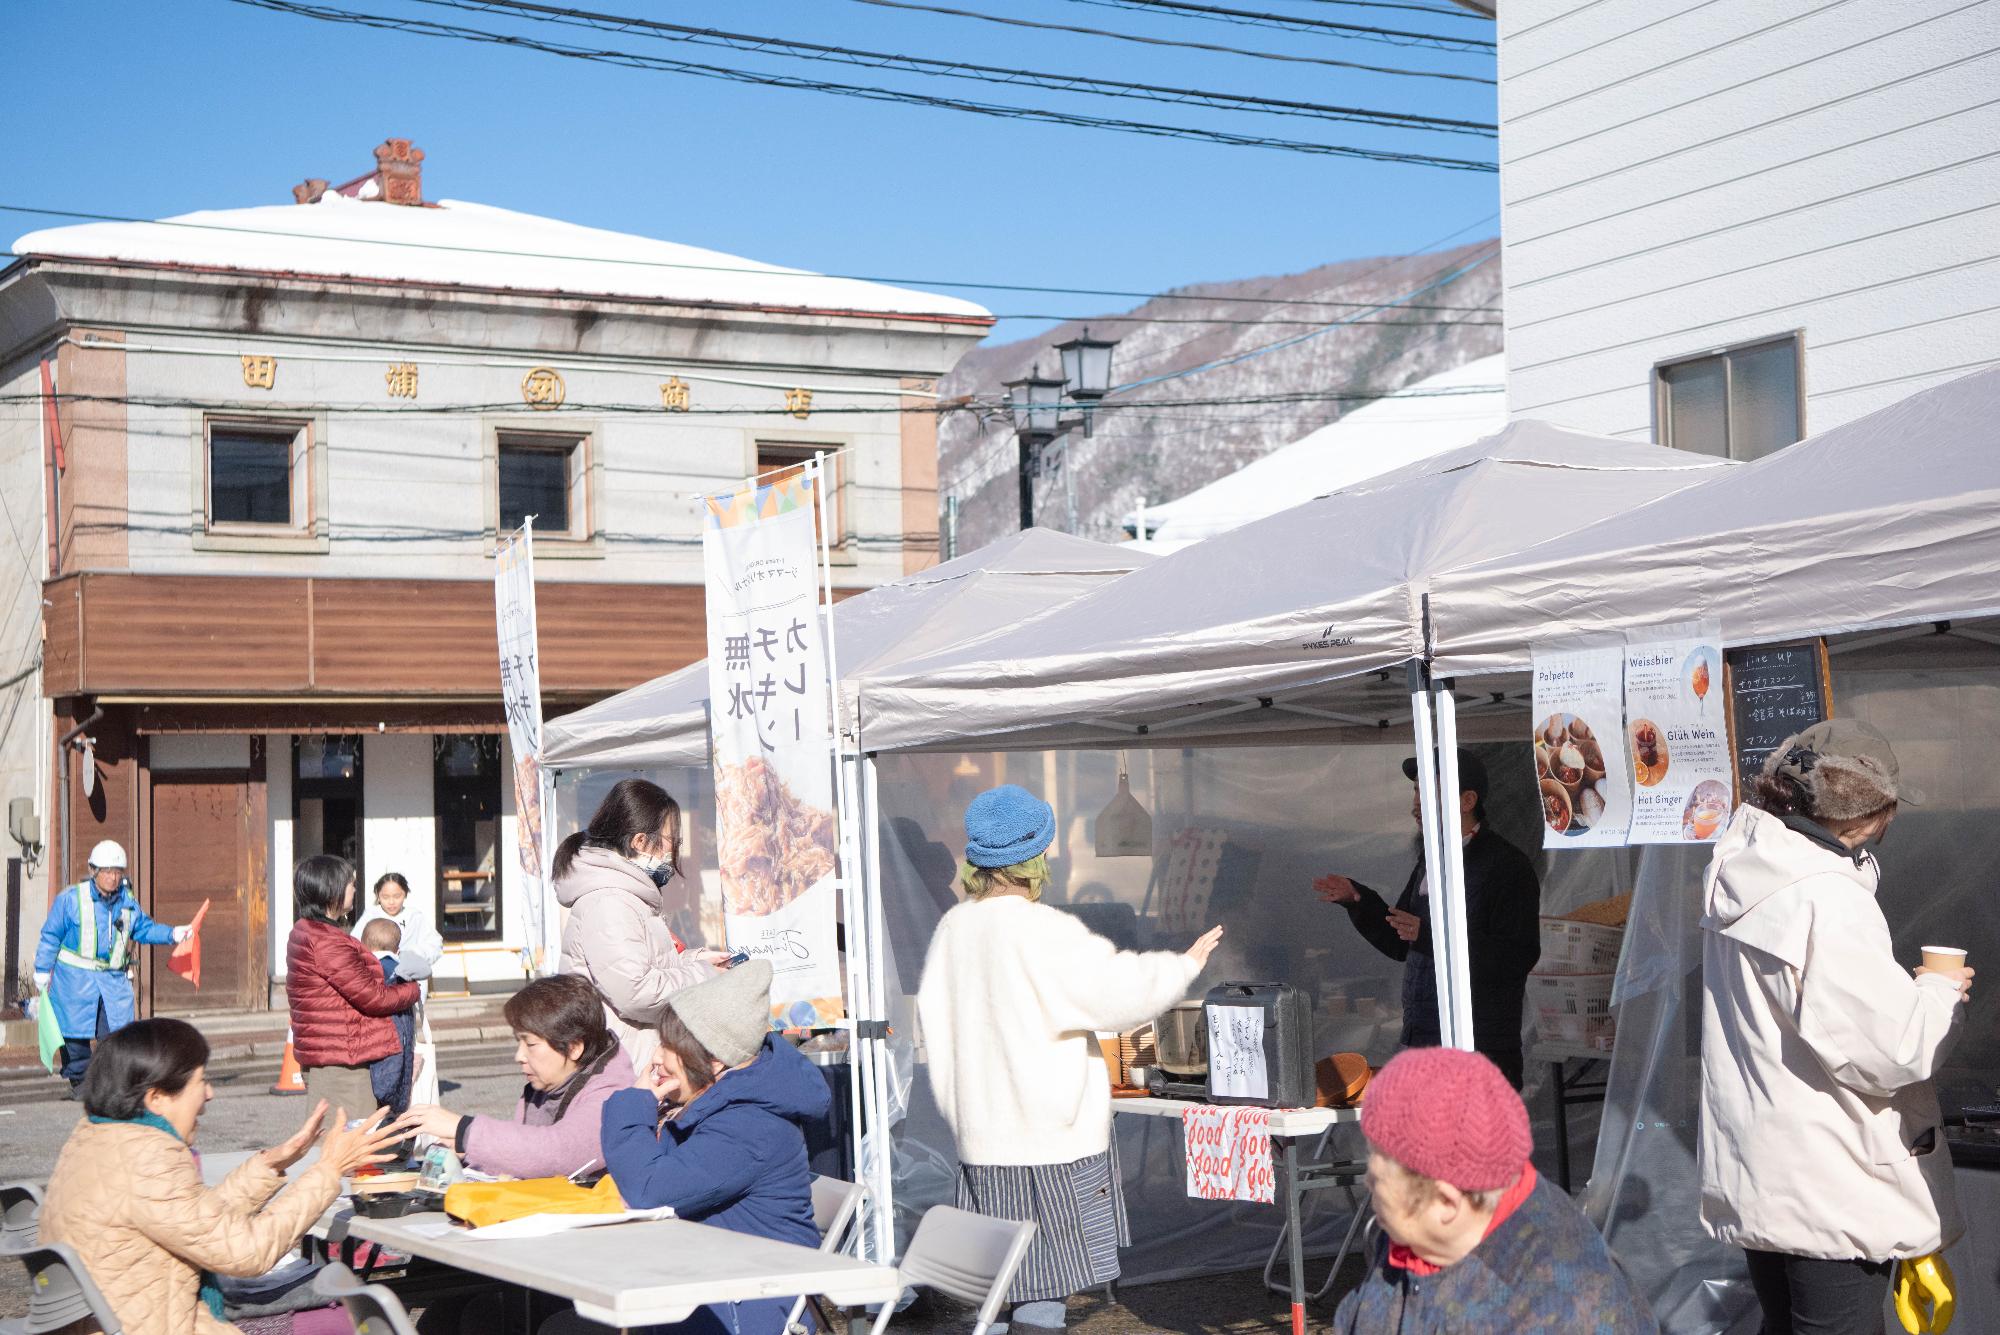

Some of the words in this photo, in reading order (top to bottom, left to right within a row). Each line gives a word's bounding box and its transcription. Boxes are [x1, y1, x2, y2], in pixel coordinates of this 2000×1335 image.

[1629, 654, 1674, 668] Weissbier
[1667, 729, 1690, 741] Glüh
[1691, 728, 1715, 740] Wein
[1638, 795, 1652, 805] Hot
[1655, 794, 1683, 807] Ginger
[1186, 1112, 1230, 1156] good
